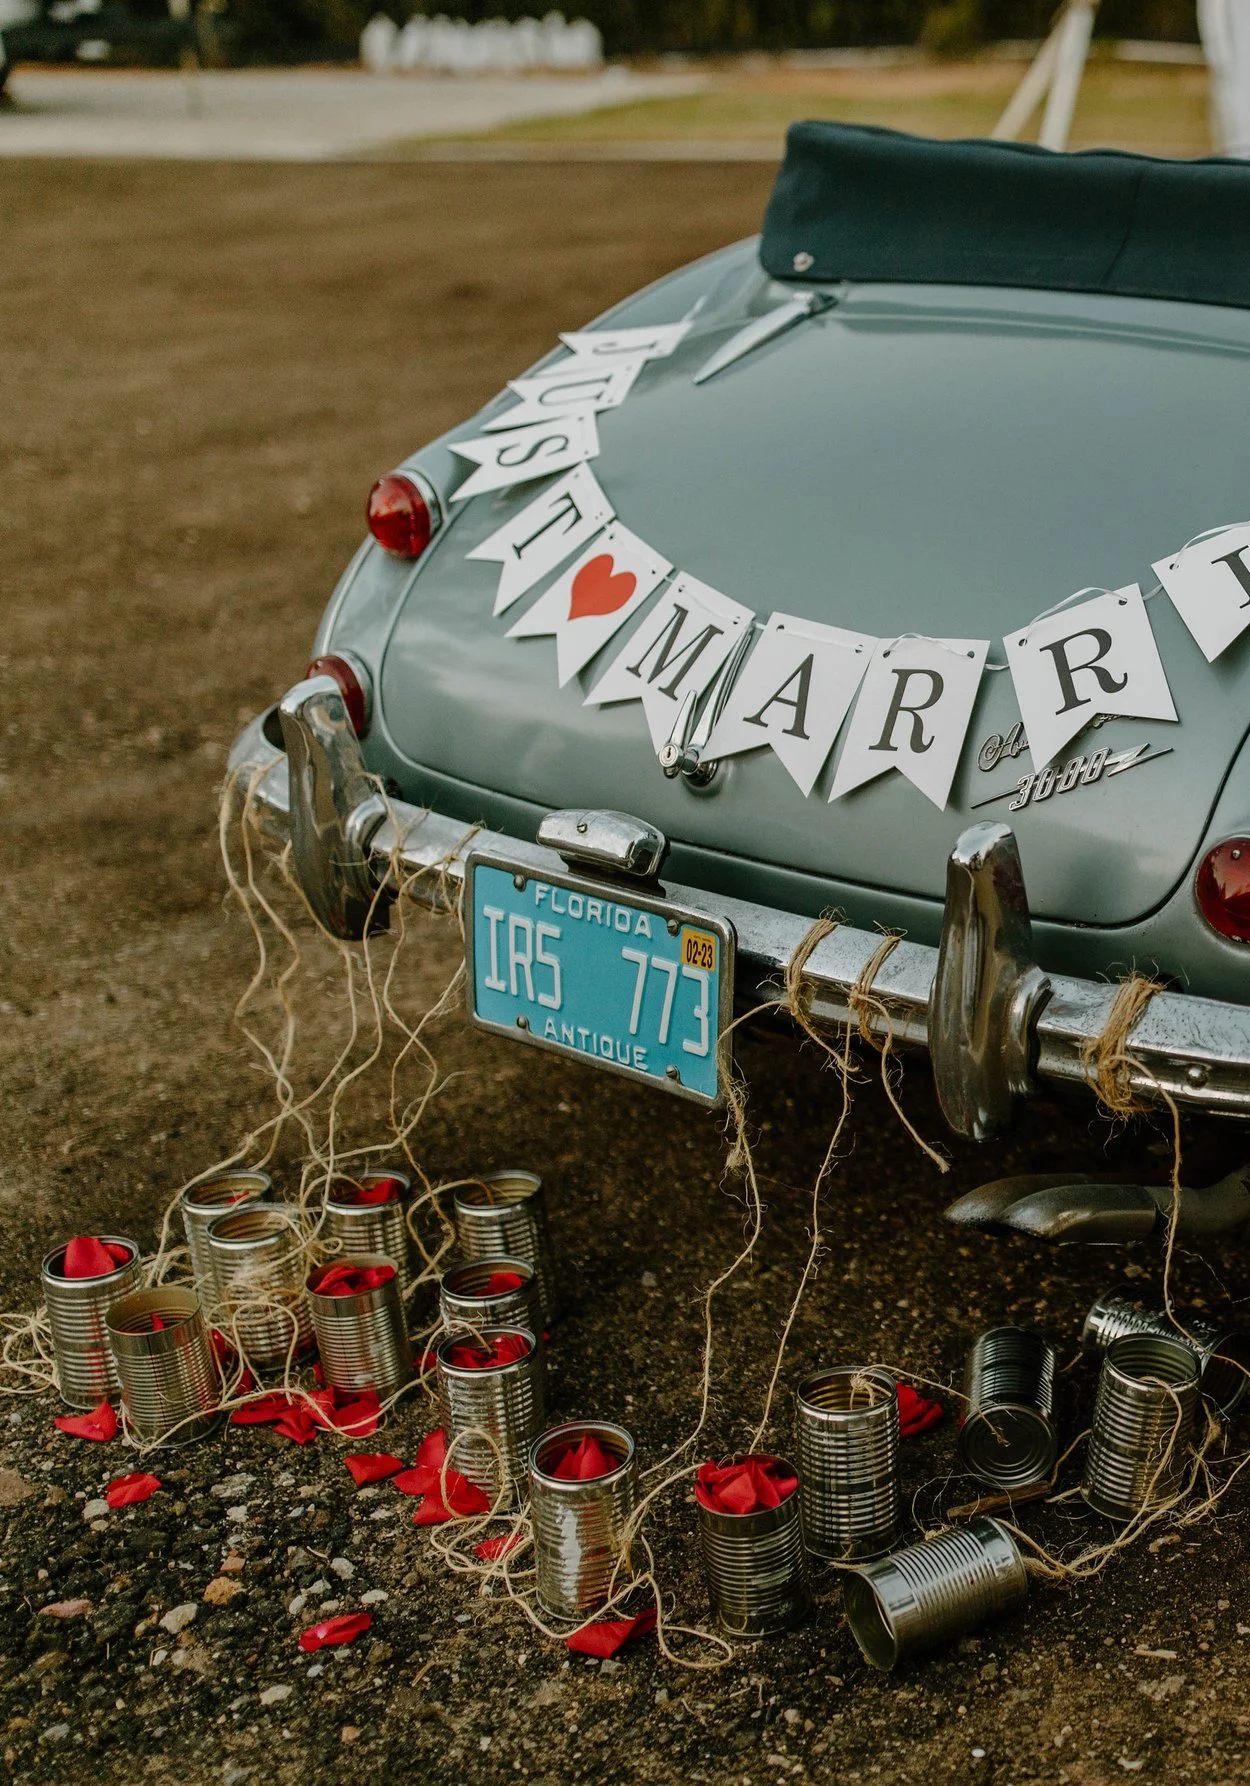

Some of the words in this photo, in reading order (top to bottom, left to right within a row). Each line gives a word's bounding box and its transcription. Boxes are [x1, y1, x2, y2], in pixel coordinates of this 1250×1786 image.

[496, 340, 659, 560] JUST
[1008, 747, 1112, 811] 3000
[535, 884, 652, 939] FLORIDA
[621, 946, 709, 1057] 773
[543, 1017, 650, 1071] ANTIQUE
